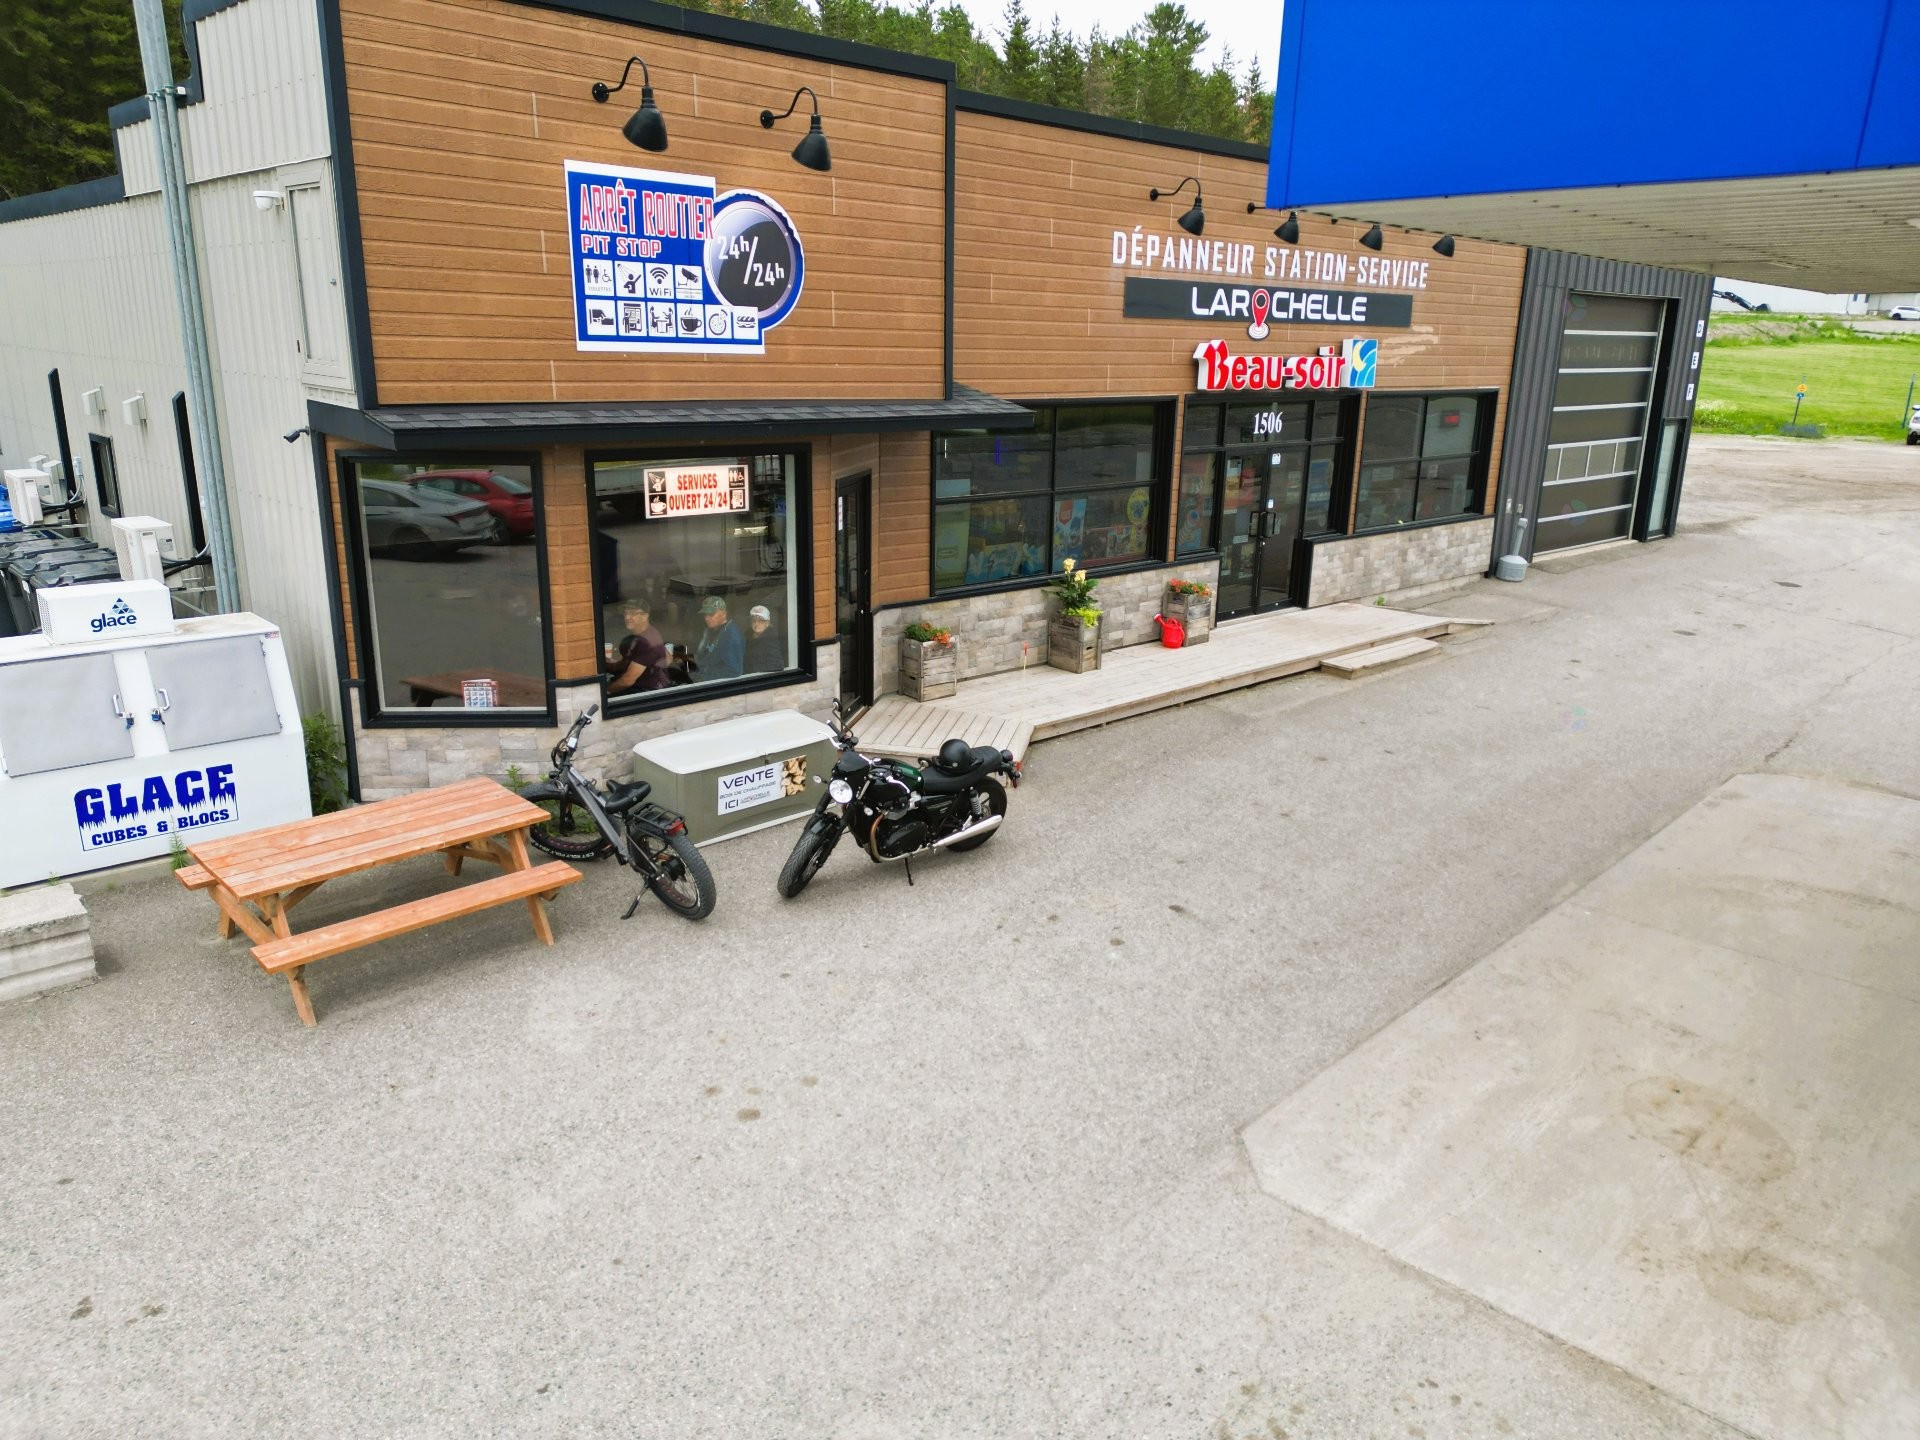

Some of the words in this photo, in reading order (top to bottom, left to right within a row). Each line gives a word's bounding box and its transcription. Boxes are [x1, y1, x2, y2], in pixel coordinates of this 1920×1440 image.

[580, 178, 637, 235] ARRÊT
[642, 190, 714, 241] ROUTIER
[581, 233, 610, 255] PIT
[616, 237, 661, 258] STOP
[1112, 225, 1254, 275] DÉPANNEUR
[1264, 246, 1429, 289] STATION-SERVICE
[1200, 339, 1346, 391] Beau-soir
[1253, 411, 1283, 435] 1506
[677, 473, 718, 491] SERVICES
[669, 493, 701, 511] OUVERT
[91, 613, 137, 632] glace
[723, 768, 774, 789] VENTE
[74, 764, 237, 829] GLACE
[725, 799, 739, 809] ICI
[91, 825, 148, 846] CUBES
[157, 820, 169, 833] &
[177, 809, 230, 829] BLOCS
